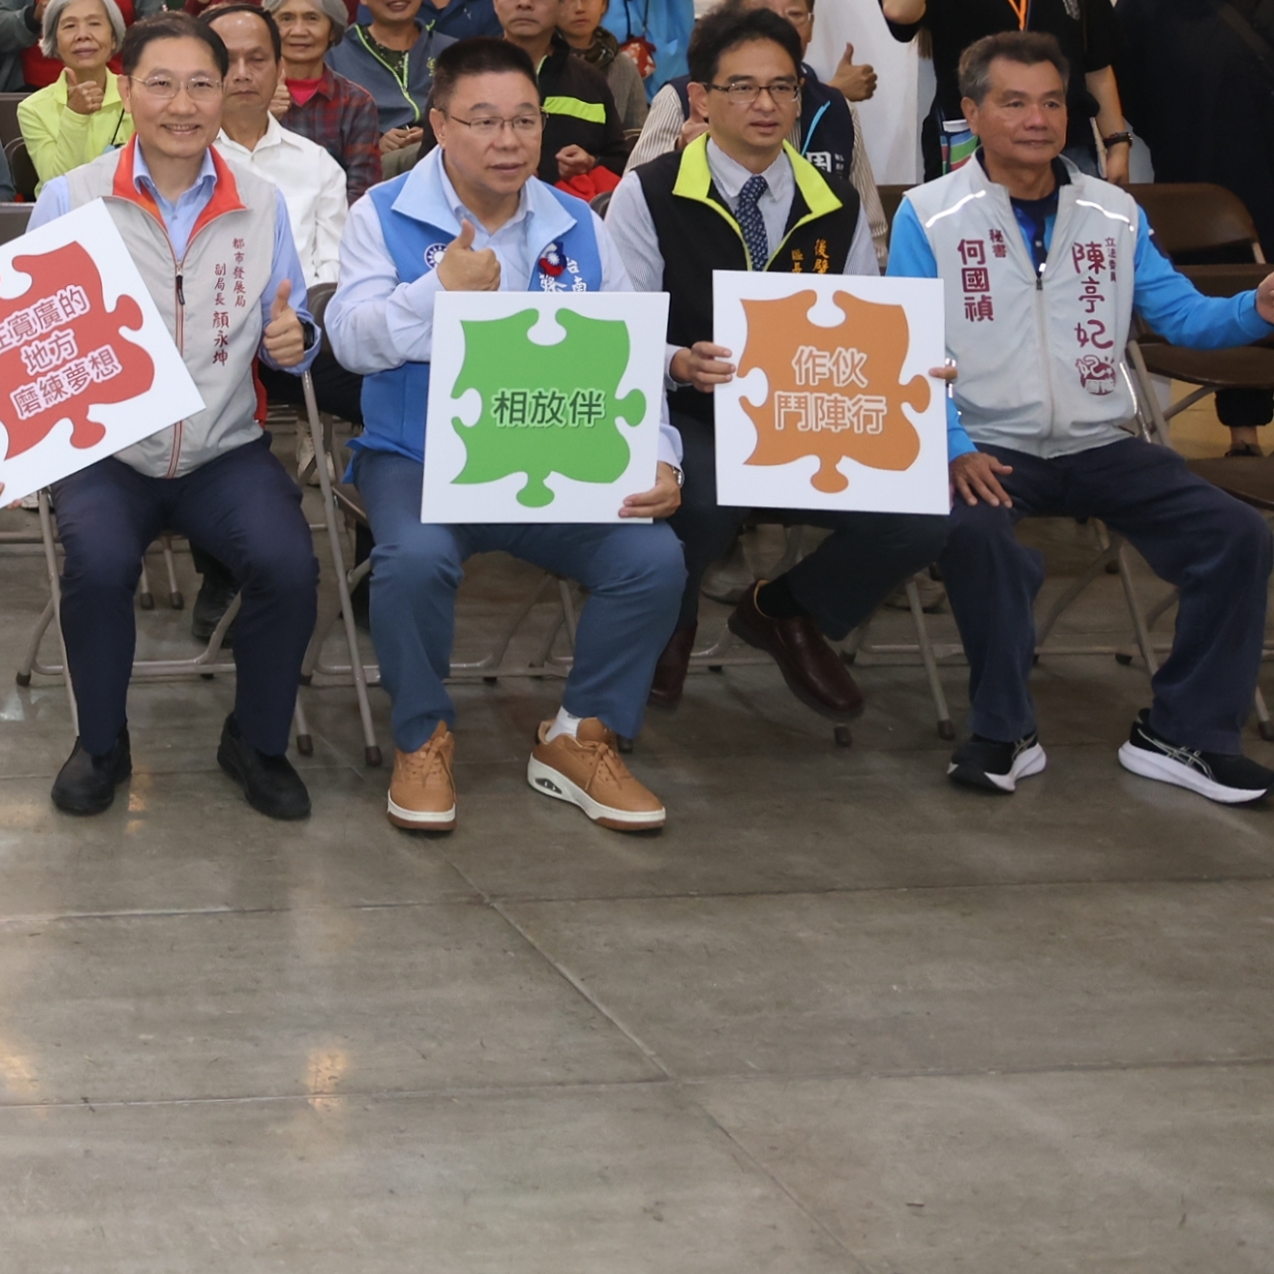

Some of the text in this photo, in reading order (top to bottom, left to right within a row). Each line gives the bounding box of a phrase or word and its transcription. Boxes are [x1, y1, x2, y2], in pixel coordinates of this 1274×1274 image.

[233, 238, 247, 308] 都市發展局
[1071, 241, 1114, 349] 陳亭妃
[212, 263, 229, 366] 副局長 顏永坤
[21, 328, 79, 375] 地方
[791, 346, 868, 389] 作伙
[10, 344, 123, 420] 磨練夢想
[492, 388, 607, 428] 相放伴
[774, 391, 887, 435] 鬥陣行
